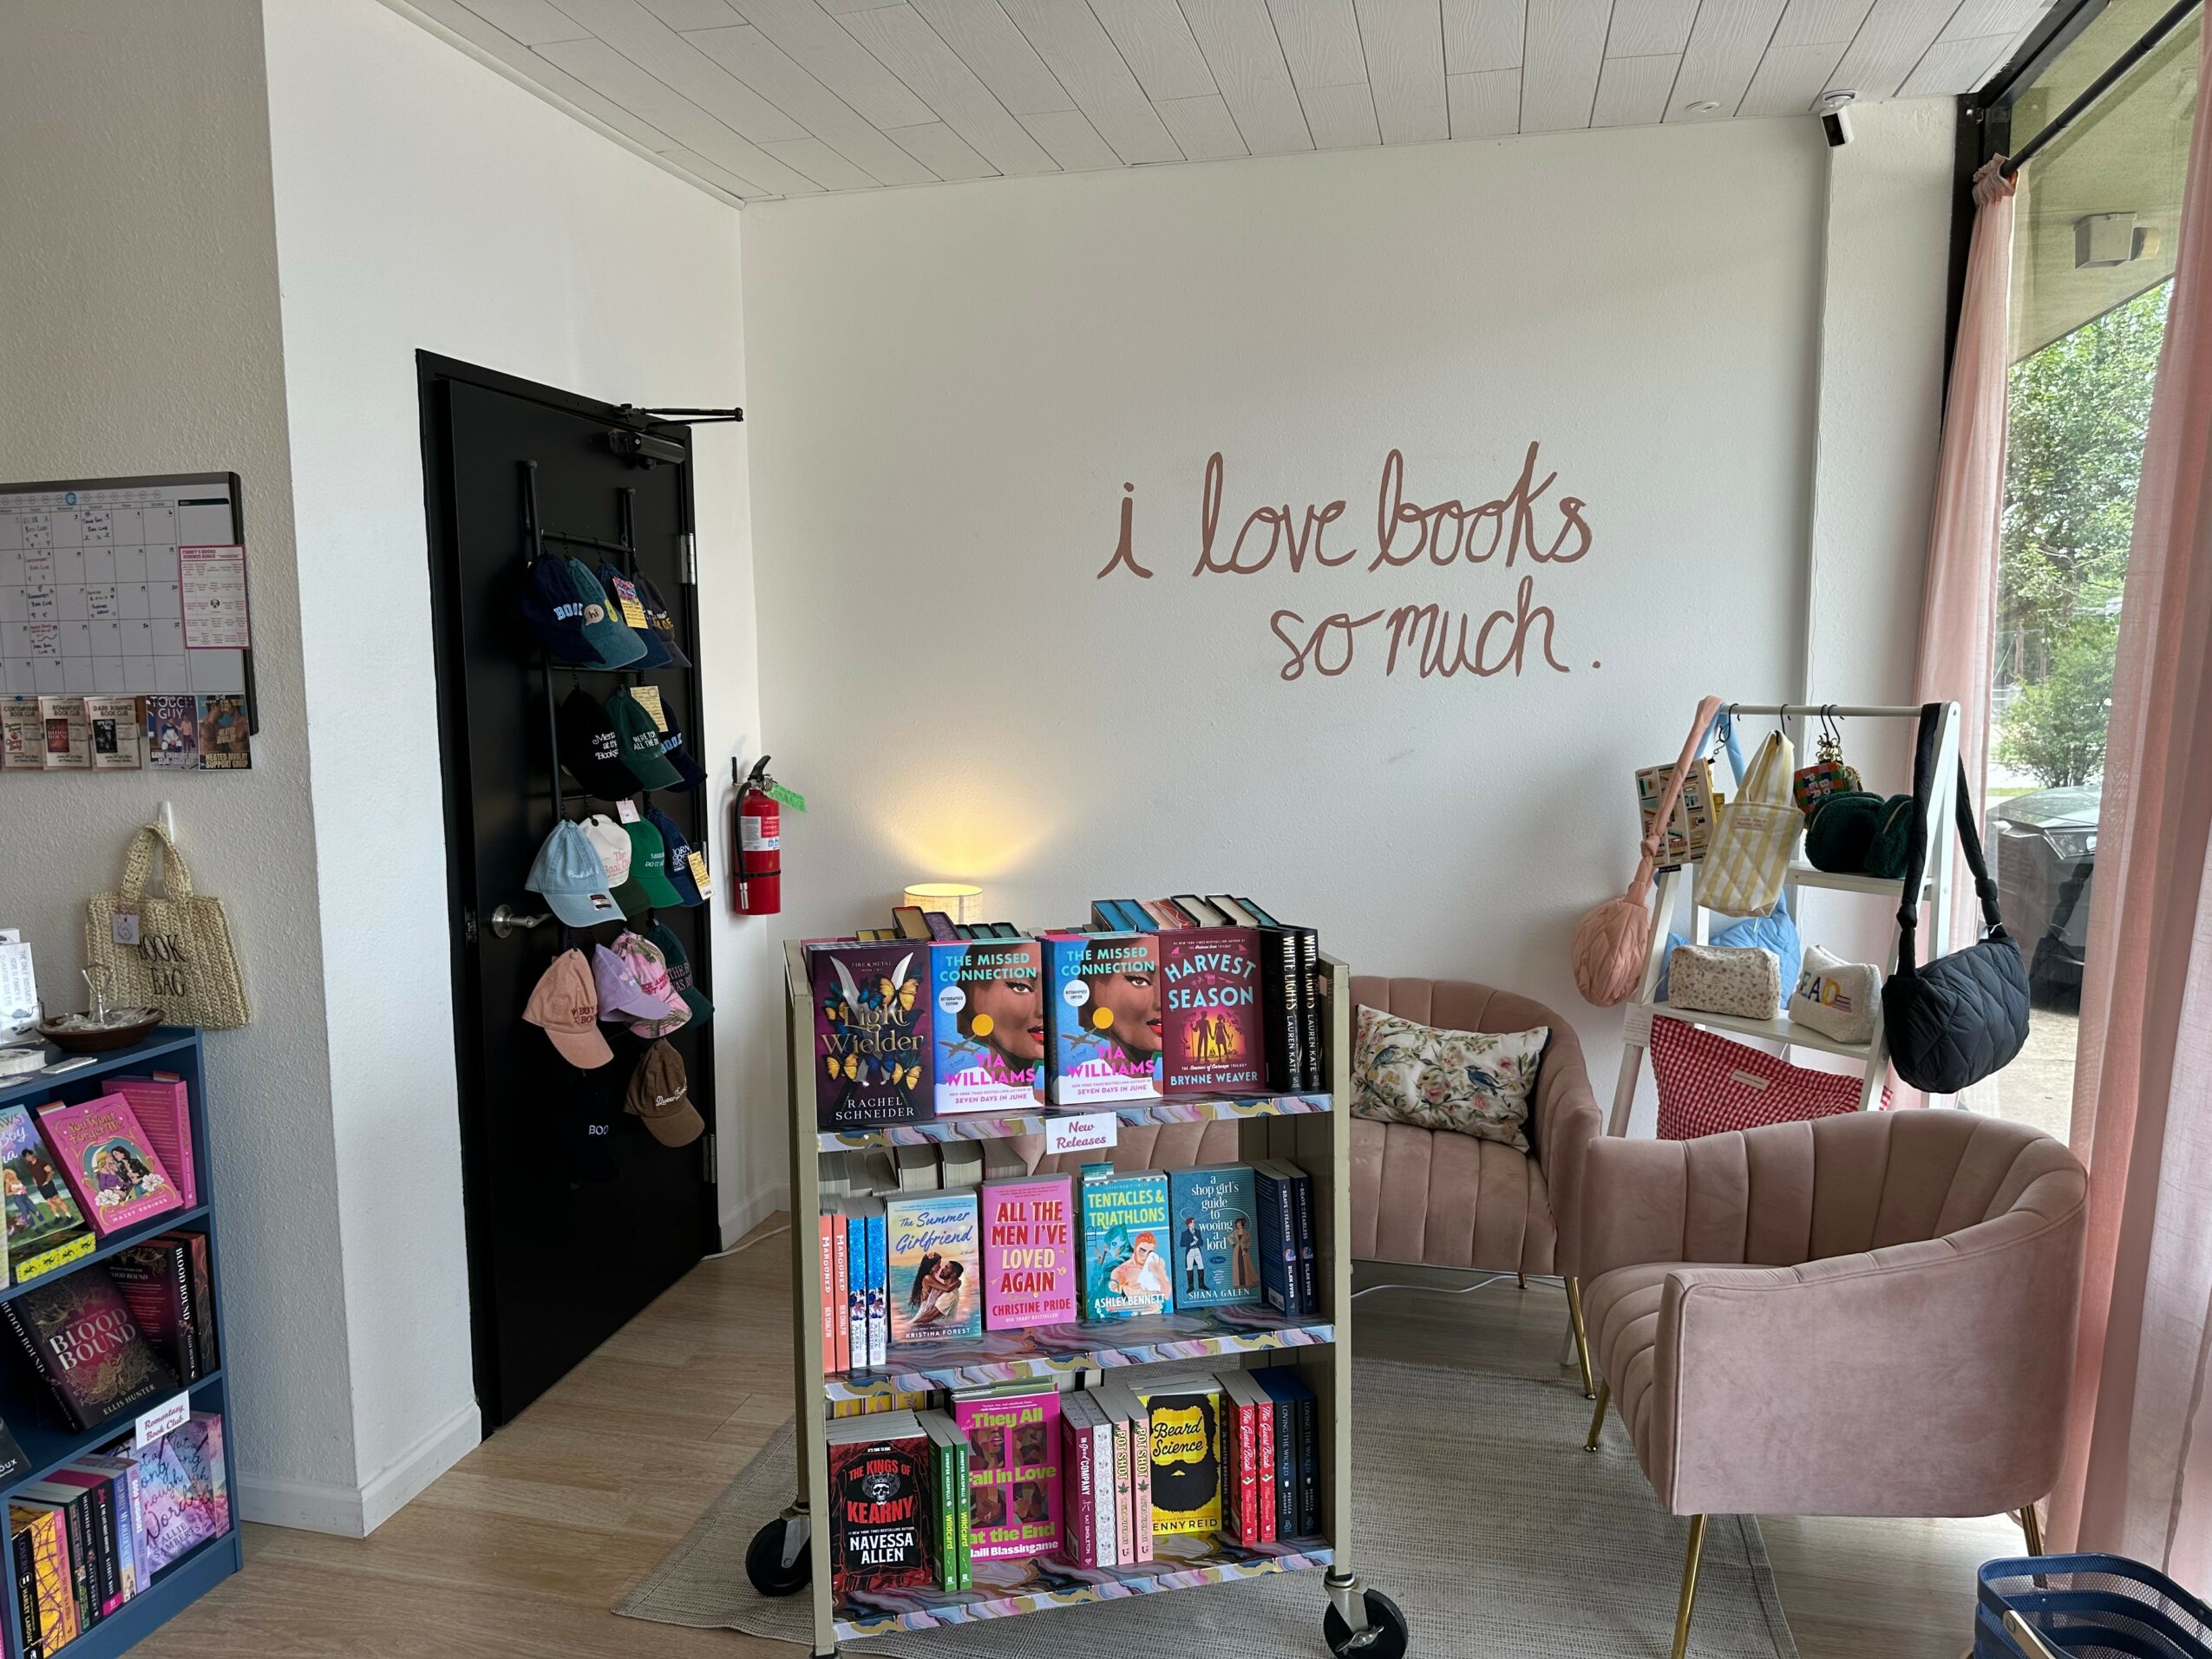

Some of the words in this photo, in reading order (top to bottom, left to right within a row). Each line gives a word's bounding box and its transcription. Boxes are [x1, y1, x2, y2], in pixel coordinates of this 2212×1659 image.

[1097, 482, 1153, 579] i
[1192, 452, 1357, 578] love
[1368, 441, 1593, 572] books
[589, 609, 599, 619] hi
[1270, 609, 1385, 681] so
[159, 709, 183, 719] GUY
[206, 753, 227, 761] HEATED
[232, 760, 248, 768] GROUP
[614, 852, 625, 861] The
[946, 954, 972, 968] THE
[977, 952, 1031, 966] MISSED
[1067, 949, 1092, 962] THE
[1097, 947, 1149, 960] MISSED
[1282, 936, 1295, 973] WHITE
[1303, 935, 1317, 971] WHITE
[939, 966, 1037, 982] CONNECTION
[1061, 961, 1155, 976] CONNECTION
[1164, 953, 1257, 983] HARVEST
[150, 967, 186, 997] BAG
[1168, 985, 1254, 1010] SEASON
[1284, 974, 1299, 1011] LIGHTS
[579, 1006, 595, 1016] BUY
[843, 1004, 911, 1034] Light
[1286, 1016, 1295, 1053] LAUREN
[1306, 1014, 1315, 1048] LAUREN
[821, 1030, 925, 1055] Wielder
[975, 1053, 1006, 1068] TIA
[1096, 1046, 1126, 1061] TIA
[1308, 1048, 1317, 1074] KATE
[945, 1067, 1037, 1087] WILLIAMS
[1067, 1060, 1155, 1078] WILLIAMS
[1170, 1073, 1213, 1087] BRYNNE
[1215, 1071, 1258, 1084] WEAVER
[980, 1094, 998, 1103] DAYS
[1008, 1093, 1027, 1101] JUNE
[1077, 1087, 1100, 1096] SEVEN
[1102, 1086, 1119, 1094] DAYS
[847, 1096, 903, 1108] RACHEL
[835, 1107, 915, 1121] SCHNEIDER
[1069, 1120, 1095, 1133] New
[1057, 1136, 1107, 1150] Releases
[1192, 1184, 1214, 1197] shop
[1216, 1181, 1240, 1196] girl's
[1210, 1175, 1216, 1185] a
[1088, 1189, 1154, 1209] TENTACLES
[1155, 1189, 1165, 1204] &
[1201, 1199, 1228, 1212] guide
[900, 1218, 914, 1228] The
[916, 1211, 971, 1228] Summer
[997, 1202, 1027, 1225] ALL
[1031, 1200, 1063, 1222] THE
[1089, 1207, 1166, 1230] TRIATHLONS
[1210, 1210, 1221, 1219] to
[991, 1225, 1028, 1247] MEN
[1034, 1223, 1067, 1245] I'VE
[1199, 1219, 1234, 1232] wooing
[1213, 1231, 1220, 1240] a
[895, 1225, 973, 1254] Girlfriend
[1207, 1237, 1227, 1251] lord
[175, 1247, 187, 1283] BLOOD
[1002, 1247, 1056, 1270] LOVED
[1000, 1271, 1056, 1294] AGAIN
[179, 1283, 191, 1322] BOUND
[1095, 1296, 1128, 1308] ASHLEY
[1129, 1293, 1166, 1306] BENNETT
[1188, 1290, 1218, 1300] SHANA
[1221, 1287, 1250, 1297] GALEN
[992, 1301, 1040, 1316] CHRISTINE
[1044, 1298, 1071, 1310] PRIDE
[49, 1308, 128, 1355] BLOOD
[906, 1330, 940, 1339] KRISTINA
[58, 1323, 137, 1371] BOUND
[102, 1401, 125, 1416] ELLIS
[125, 1384, 156, 1402] HUNTER
[144, 1403, 186, 1429] Romantasy
[972, 1412, 1017, 1428] They
[1020, 1407, 1044, 1424] All
[1242, 1408, 1253, 1424] The
[1261, 1407, 1272, 1421] The
[146, 1427, 165, 1441] Book
[166, 1415, 184, 1431] Club
[1136, 1429, 1147, 1447] POT
[1154, 1416, 1202, 1440] Beard
[1240, 1425, 1253, 1448] Guest
[1260, 1422, 1272, 1445] Guest
[1116, 1431, 1127, 1450] POT
[1152, 1440, 1204, 1457] Science
[1117, 1453, 1128, 1479] SHOT
[1138, 1450, 1149, 1477] SHOT
[1244, 1448, 1253, 1472] Book
[1263, 1445, 1272, 1469] Book
[848, 1466, 864, 1481] THE
[866, 1459, 900, 1474] KINGS
[900, 1463, 913, 1476] OF
[997, 1467, 1012, 1483] in
[1015, 1466, 1057, 1481] Love
[1080, 1460, 1090, 1495] COMPANY
[847, 1495, 914, 1525] KEARNY
[161, 1521, 187, 1543] ALLIE
[970, 1532, 986, 1545] at
[990, 1527, 1020, 1544] the
[1022, 1521, 1056, 1539] End
[1188, 1518, 1218, 1528] REID
[154, 1523, 201, 1559] SAMBERTS
[850, 1532, 914, 1551] NAVESSA
[991, 1540, 1059, 1558] Blassingame
[861, 1547, 904, 1564] ALLEN
[21, 1589, 31, 1615] HARLEY
[24, 1615, 33, 1644] LAROUX
